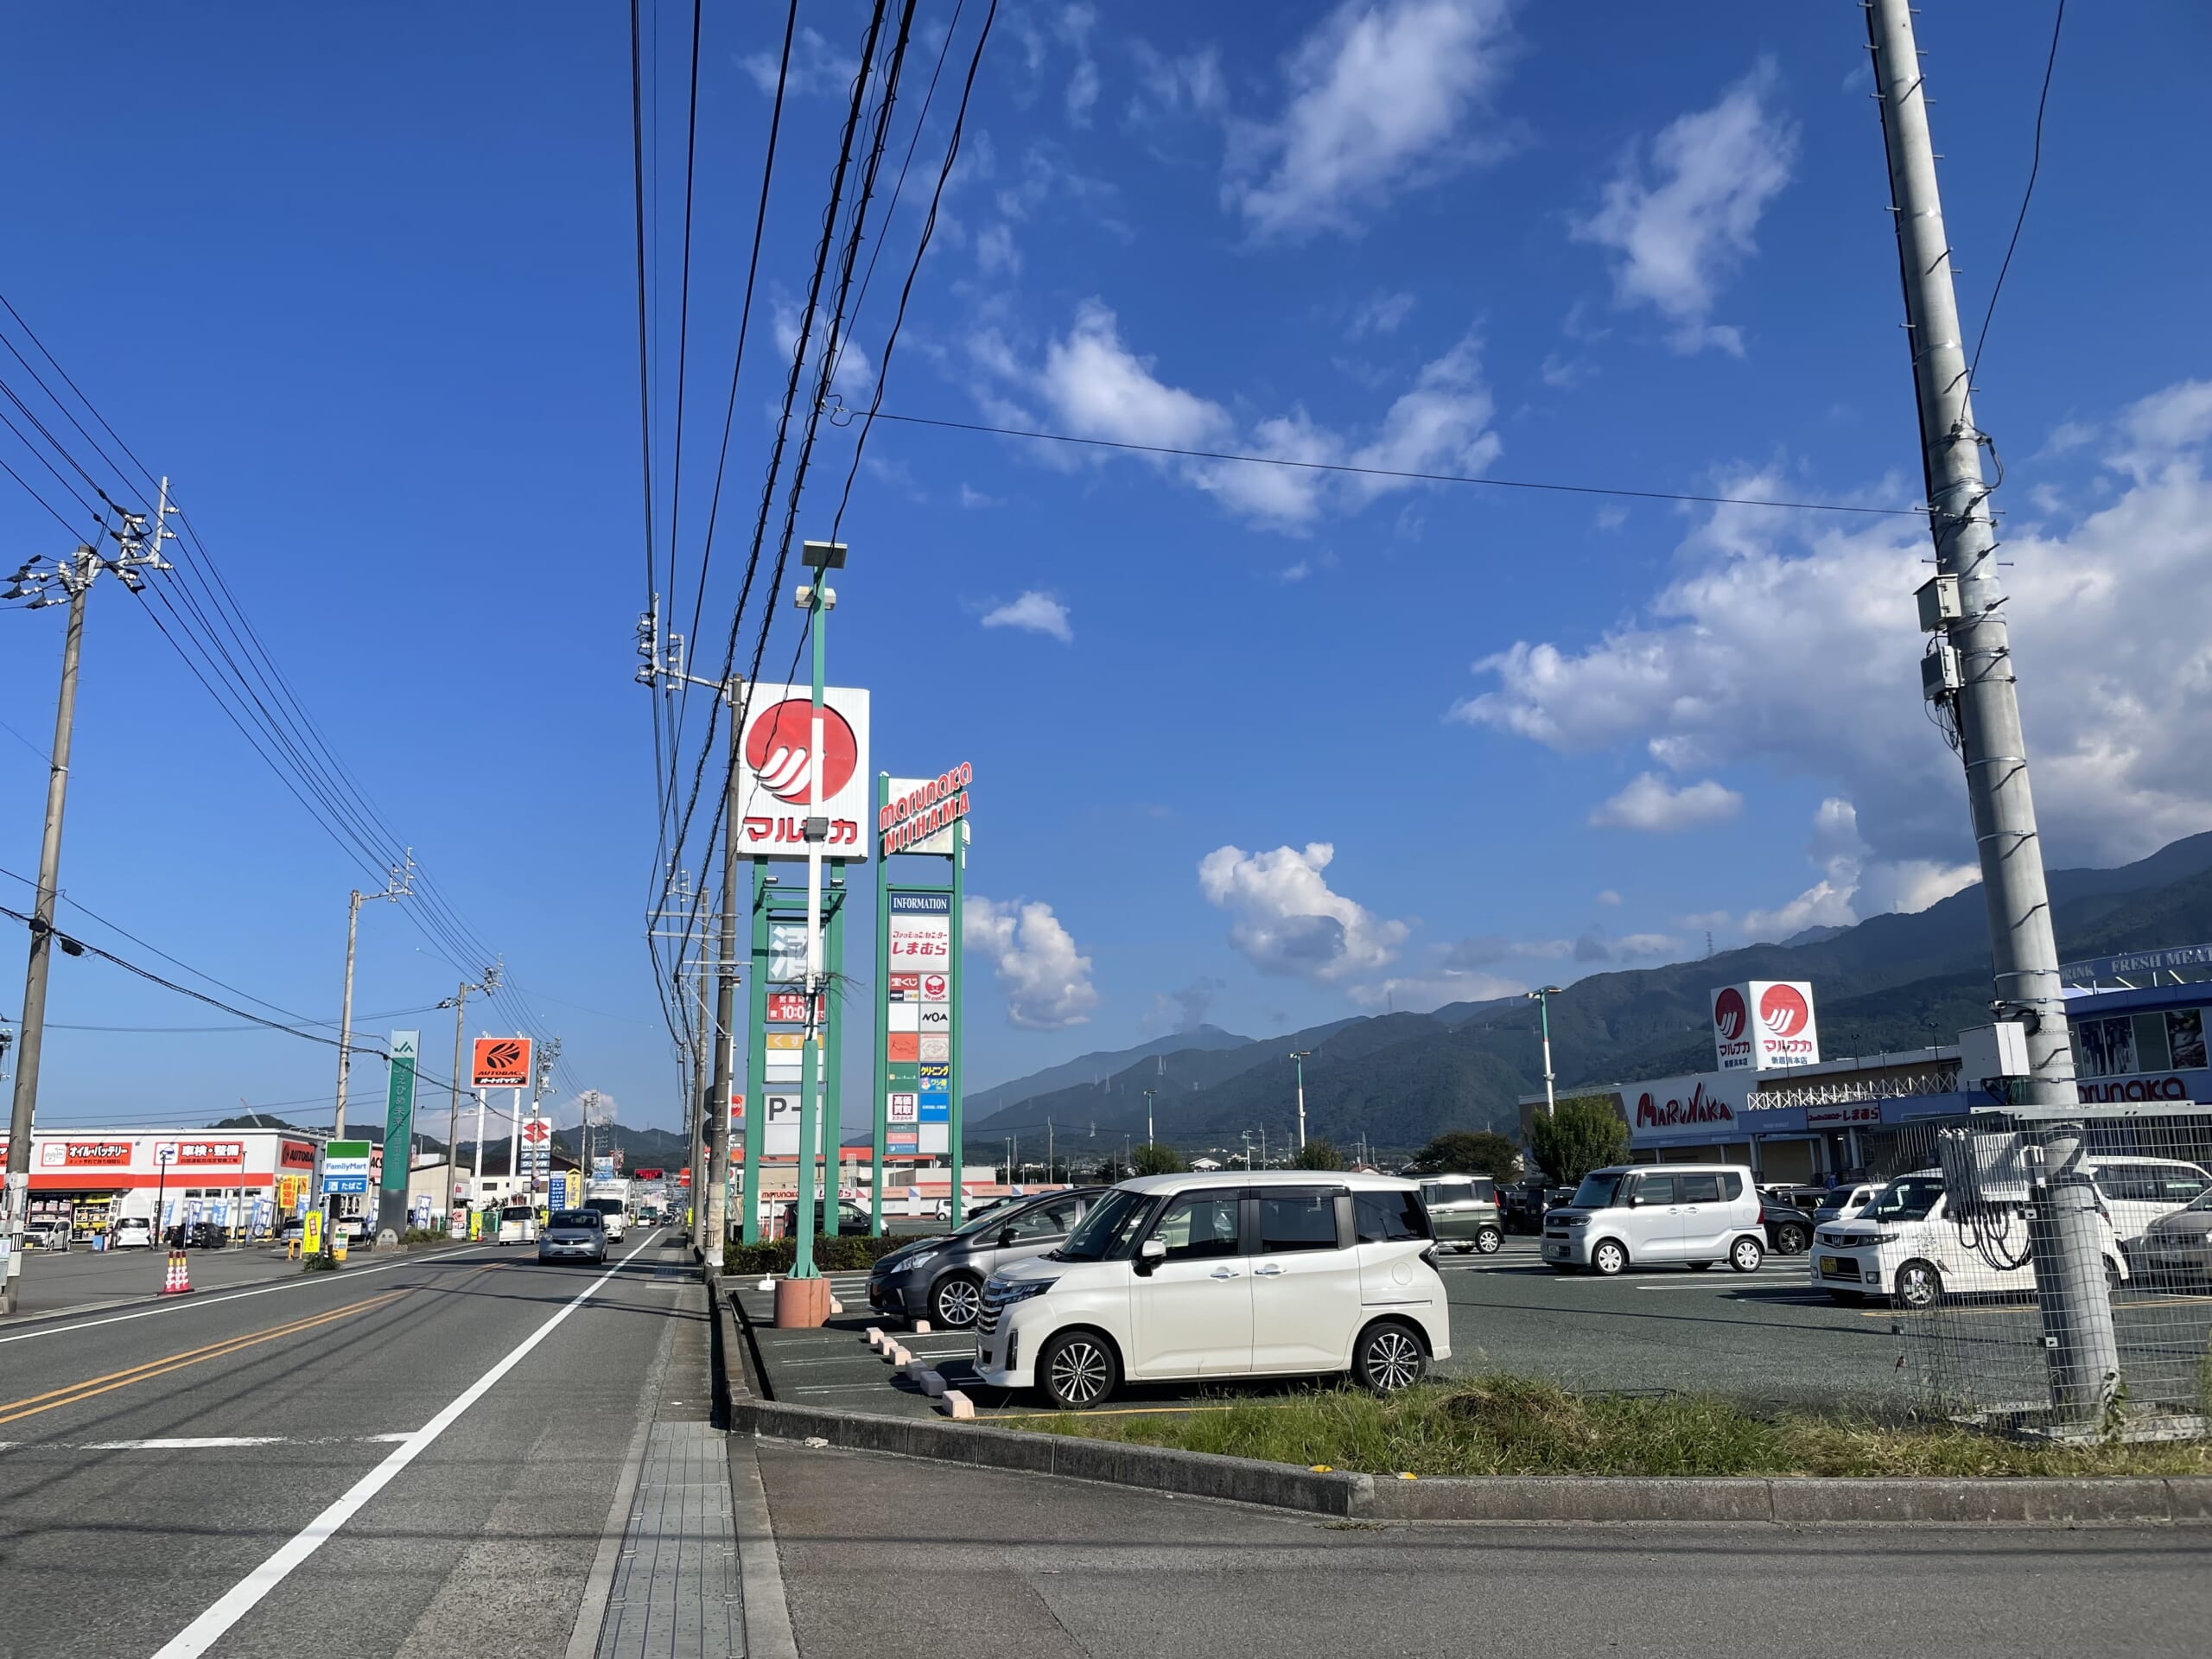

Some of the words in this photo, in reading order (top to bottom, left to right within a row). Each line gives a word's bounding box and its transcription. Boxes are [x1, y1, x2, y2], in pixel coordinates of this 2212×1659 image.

[744, 816, 858, 844] マルカ
[884, 791, 970, 856] NIIHAMA
[893, 897, 948, 910] INFORMATION
[893, 941, 948, 956] しまむら
[2111, 953, 2162, 973] FRESH
[921, 1012, 949, 1023] NOA
[773, 1034, 803, 1047] くす
[1764, 1039, 1813, 1052] マルナカ
[1719, 1041, 1751, 1056] マルナカ
[920, 1065, 949, 1076] クリーニング
[768, 1097, 787, 1121] P
[1842, 1106, 1879, 1122] しまむら
[69, 1145, 128, 1158] オイル・バッテリー
[181, 1143, 241, 1157] 車検・整備
[326, 1162, 366, 1172] FamilyMart
[341, 1181, 363, 1191] たばこ
